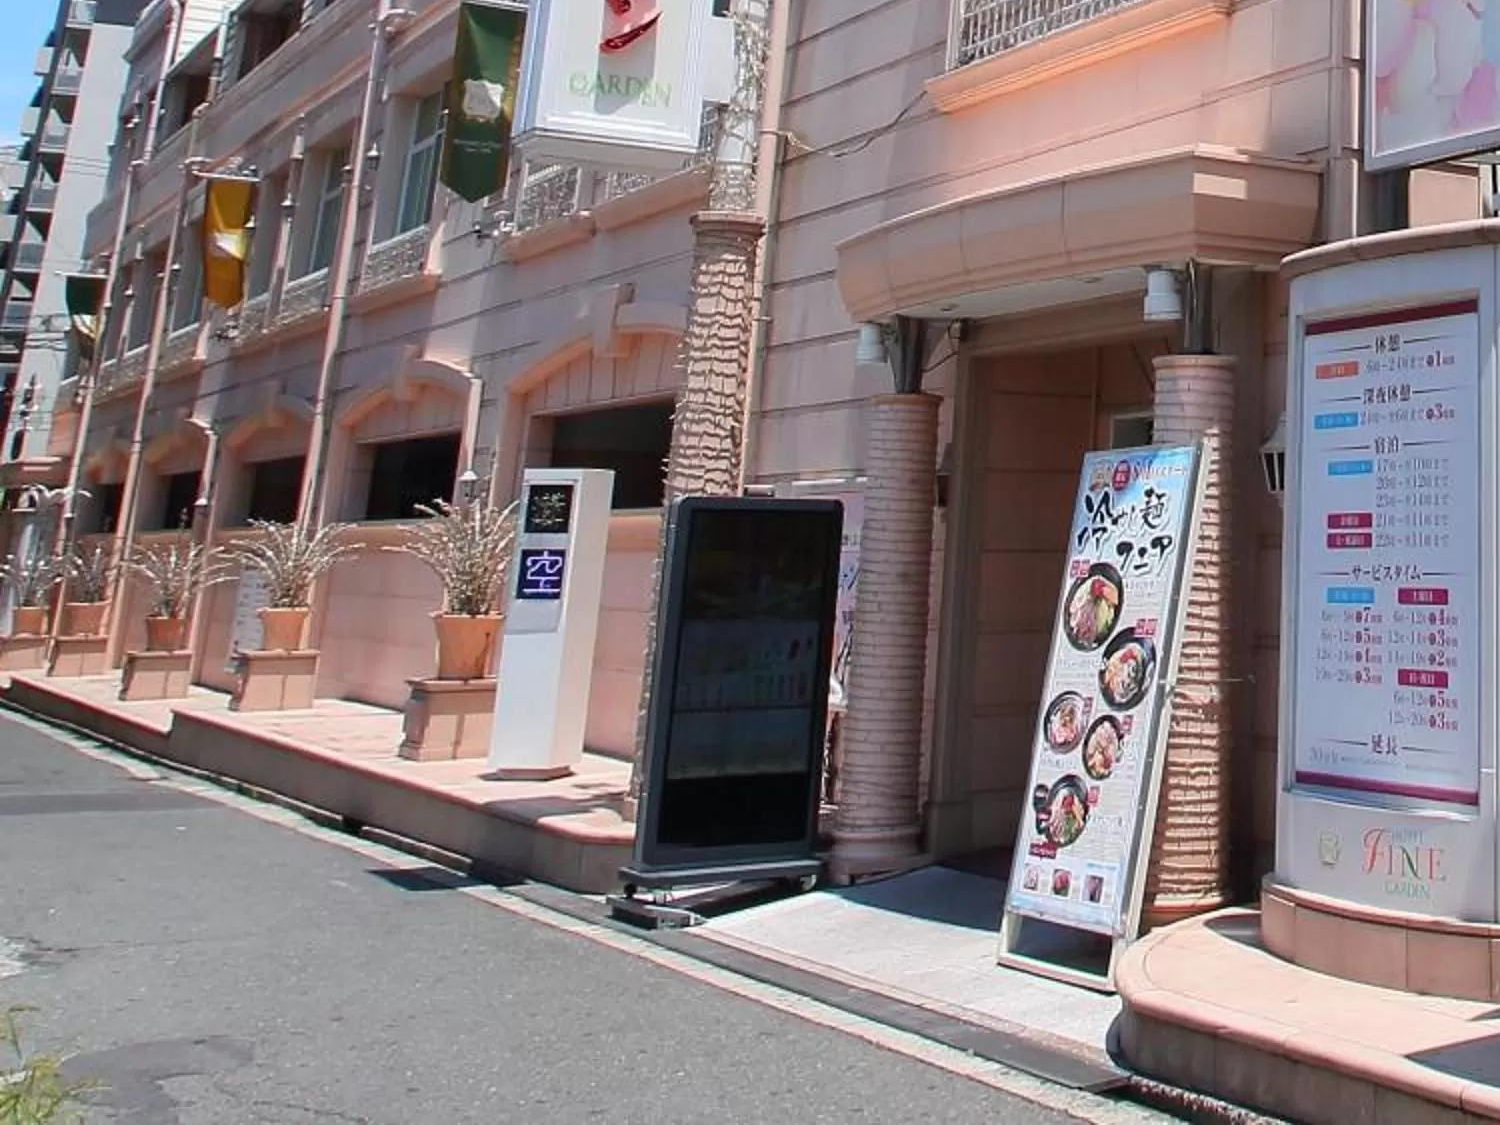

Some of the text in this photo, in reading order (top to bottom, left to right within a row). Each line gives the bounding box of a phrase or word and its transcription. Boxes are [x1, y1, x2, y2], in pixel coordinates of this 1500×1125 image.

[568, 72, 674, 108] GARDEN
[521, 550, 564, 594] 空
[1351, 563, 1422, 582] サービスタイム
[1360, 827, 1448, 882] FINE
